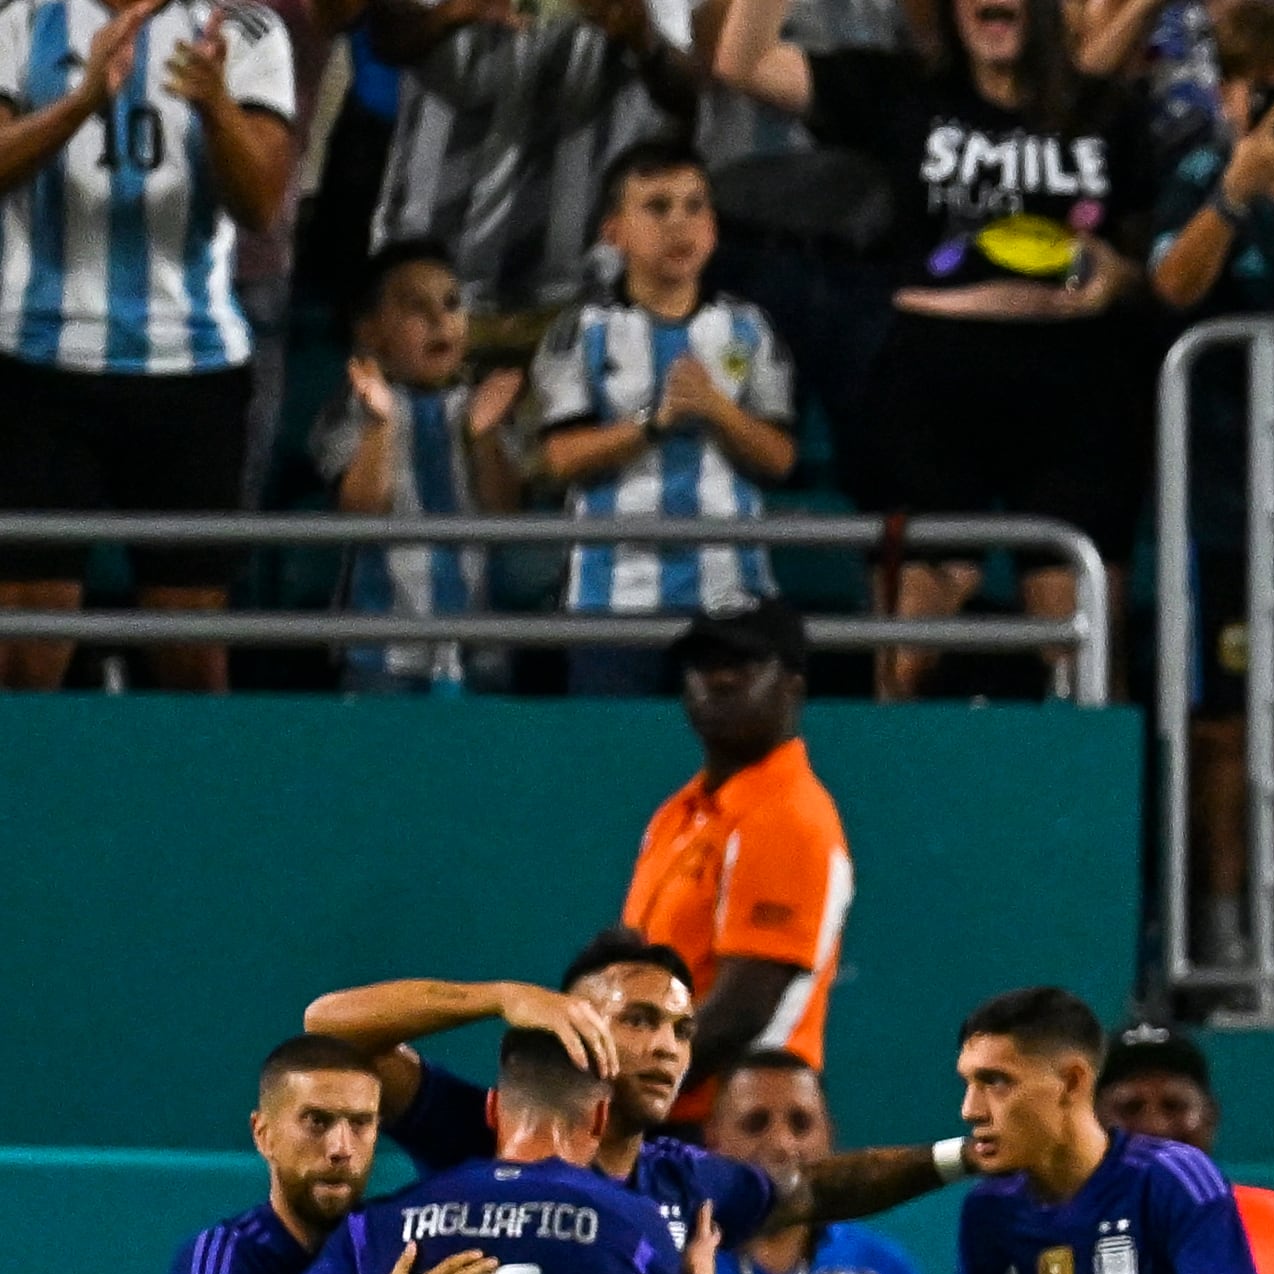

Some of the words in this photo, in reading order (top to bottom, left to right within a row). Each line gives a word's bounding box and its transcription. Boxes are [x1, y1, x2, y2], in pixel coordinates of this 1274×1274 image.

[98, 104, 164, 172] 10
[920, 126, 1110, 196] SMILE
[401, 1202, 598, 1244] TAGLIAFICO
